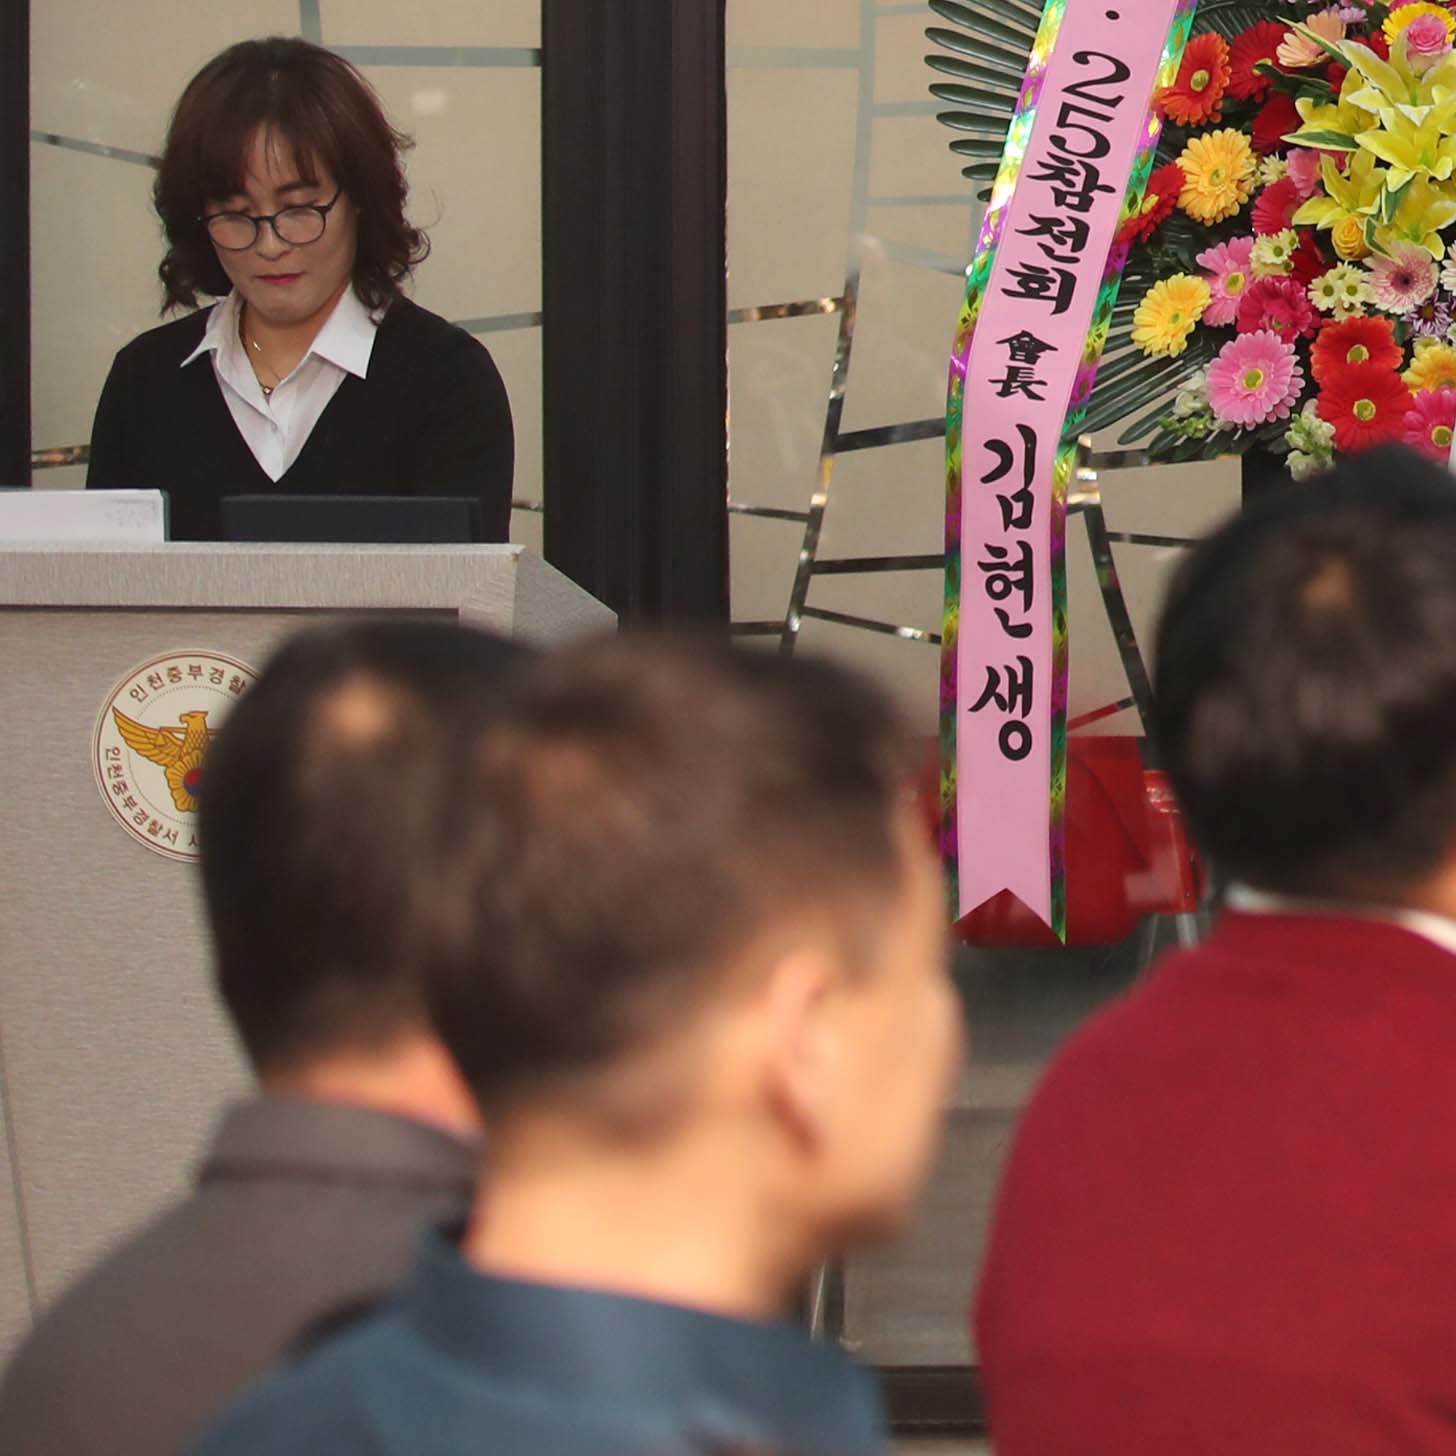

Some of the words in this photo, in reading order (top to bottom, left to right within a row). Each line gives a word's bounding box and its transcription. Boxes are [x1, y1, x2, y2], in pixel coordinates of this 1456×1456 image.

[990, 329, 1058, 401] 會長
[969, 423, 1037, 761] 김현생
[129, 663, 248, 703] 인천중부경찰
[105, 746, 180, 846] 인천중부경찰서
